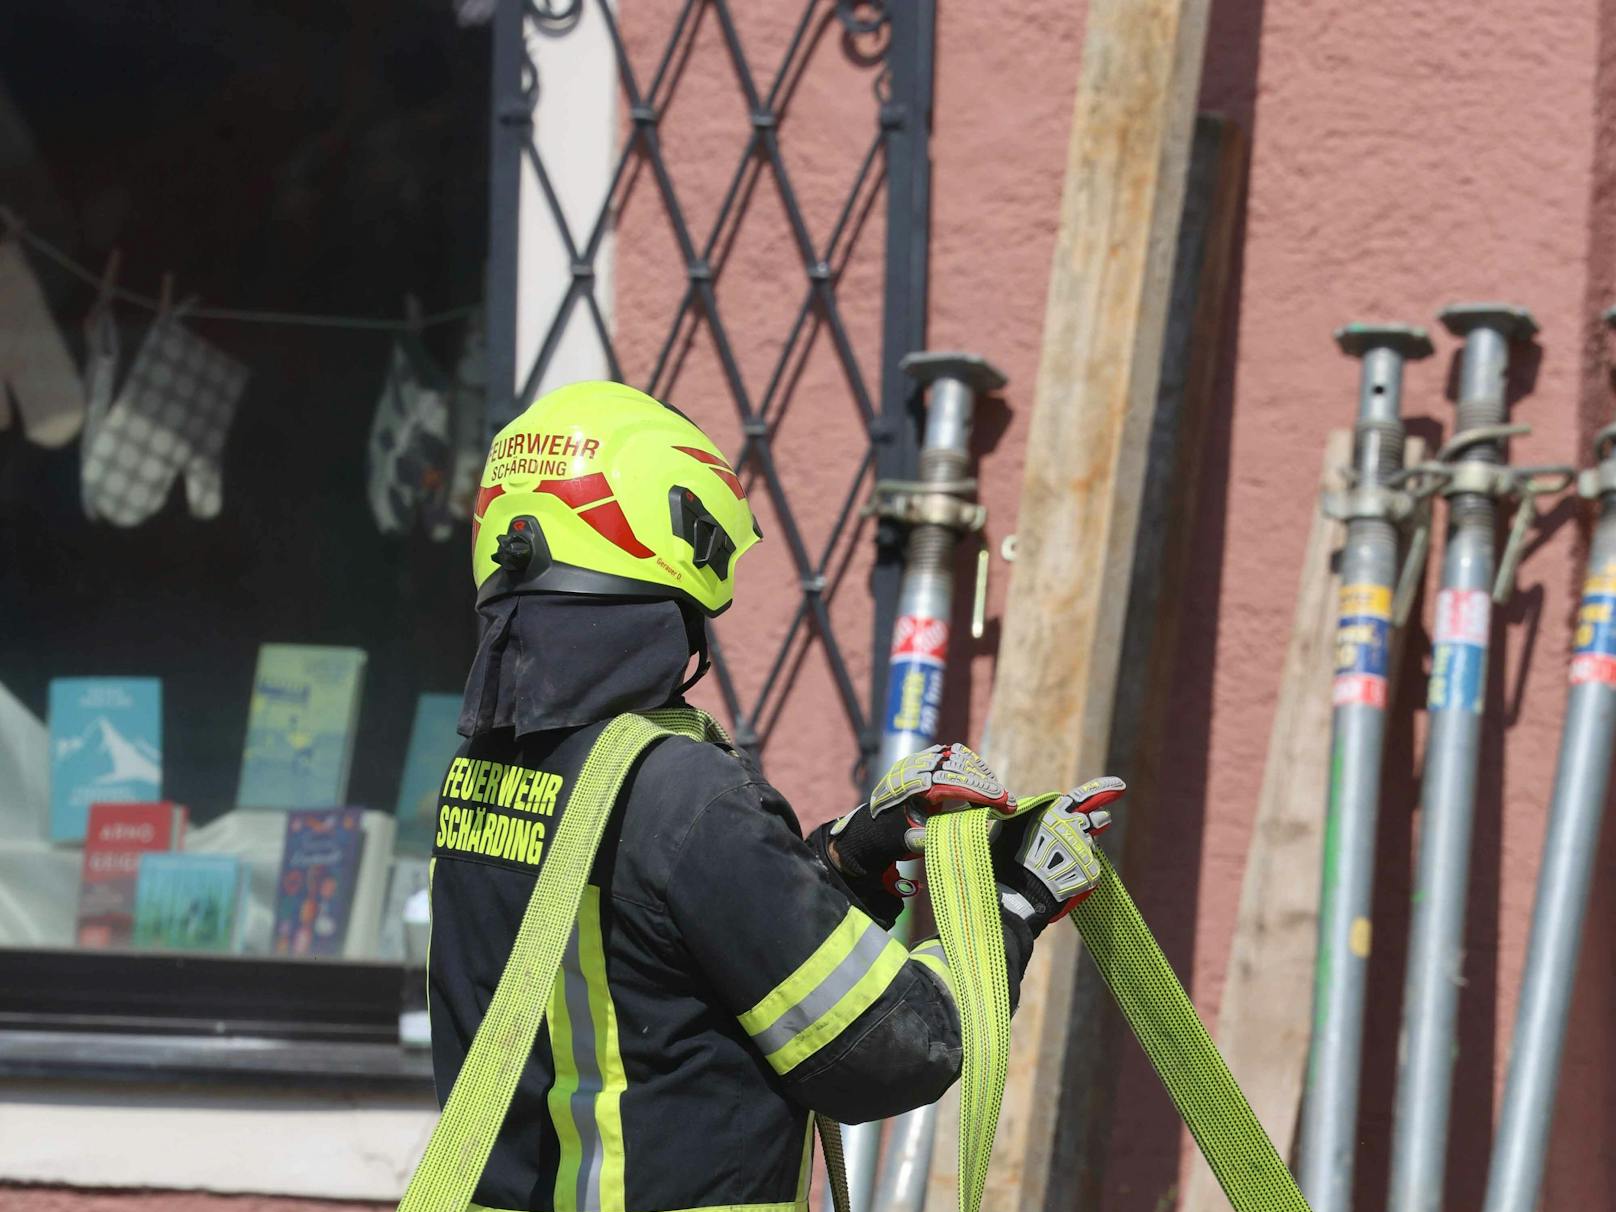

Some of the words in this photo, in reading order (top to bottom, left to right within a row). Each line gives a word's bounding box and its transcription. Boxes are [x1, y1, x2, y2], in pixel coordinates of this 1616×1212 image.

[490, 433, 600, 462] FEUERWEHR
[491, 456, 567, 481] SCHÄRDING
[442, 757, 563, 816] FEUERWEHR
[436, 804, 545, 866] SCHÄRDING
